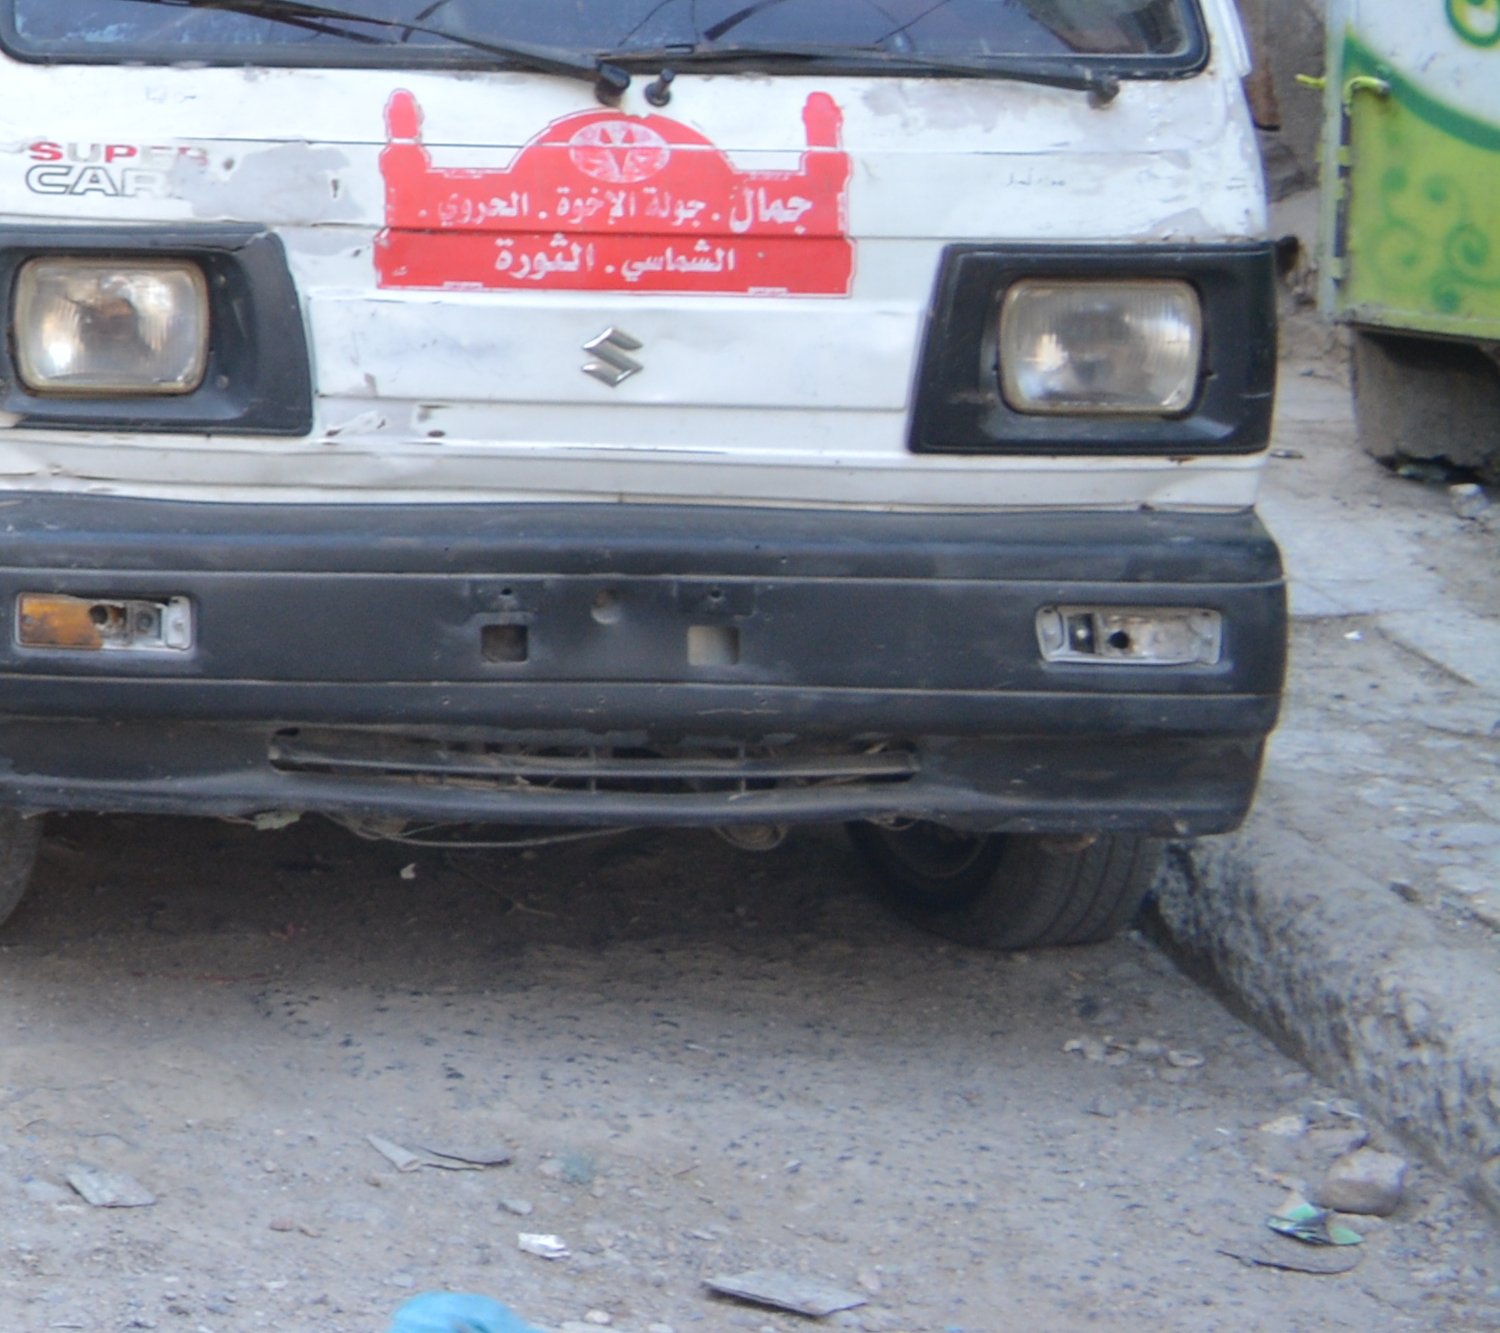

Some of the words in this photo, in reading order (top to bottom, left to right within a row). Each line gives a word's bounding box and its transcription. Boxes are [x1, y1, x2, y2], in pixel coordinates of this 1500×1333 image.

[643, 185, 706, 226] جولة
[729, 187, 812, 234] جمال
[493, 233, 594, 280] الثورة
[620, 238, 736, 282] الشماسي
